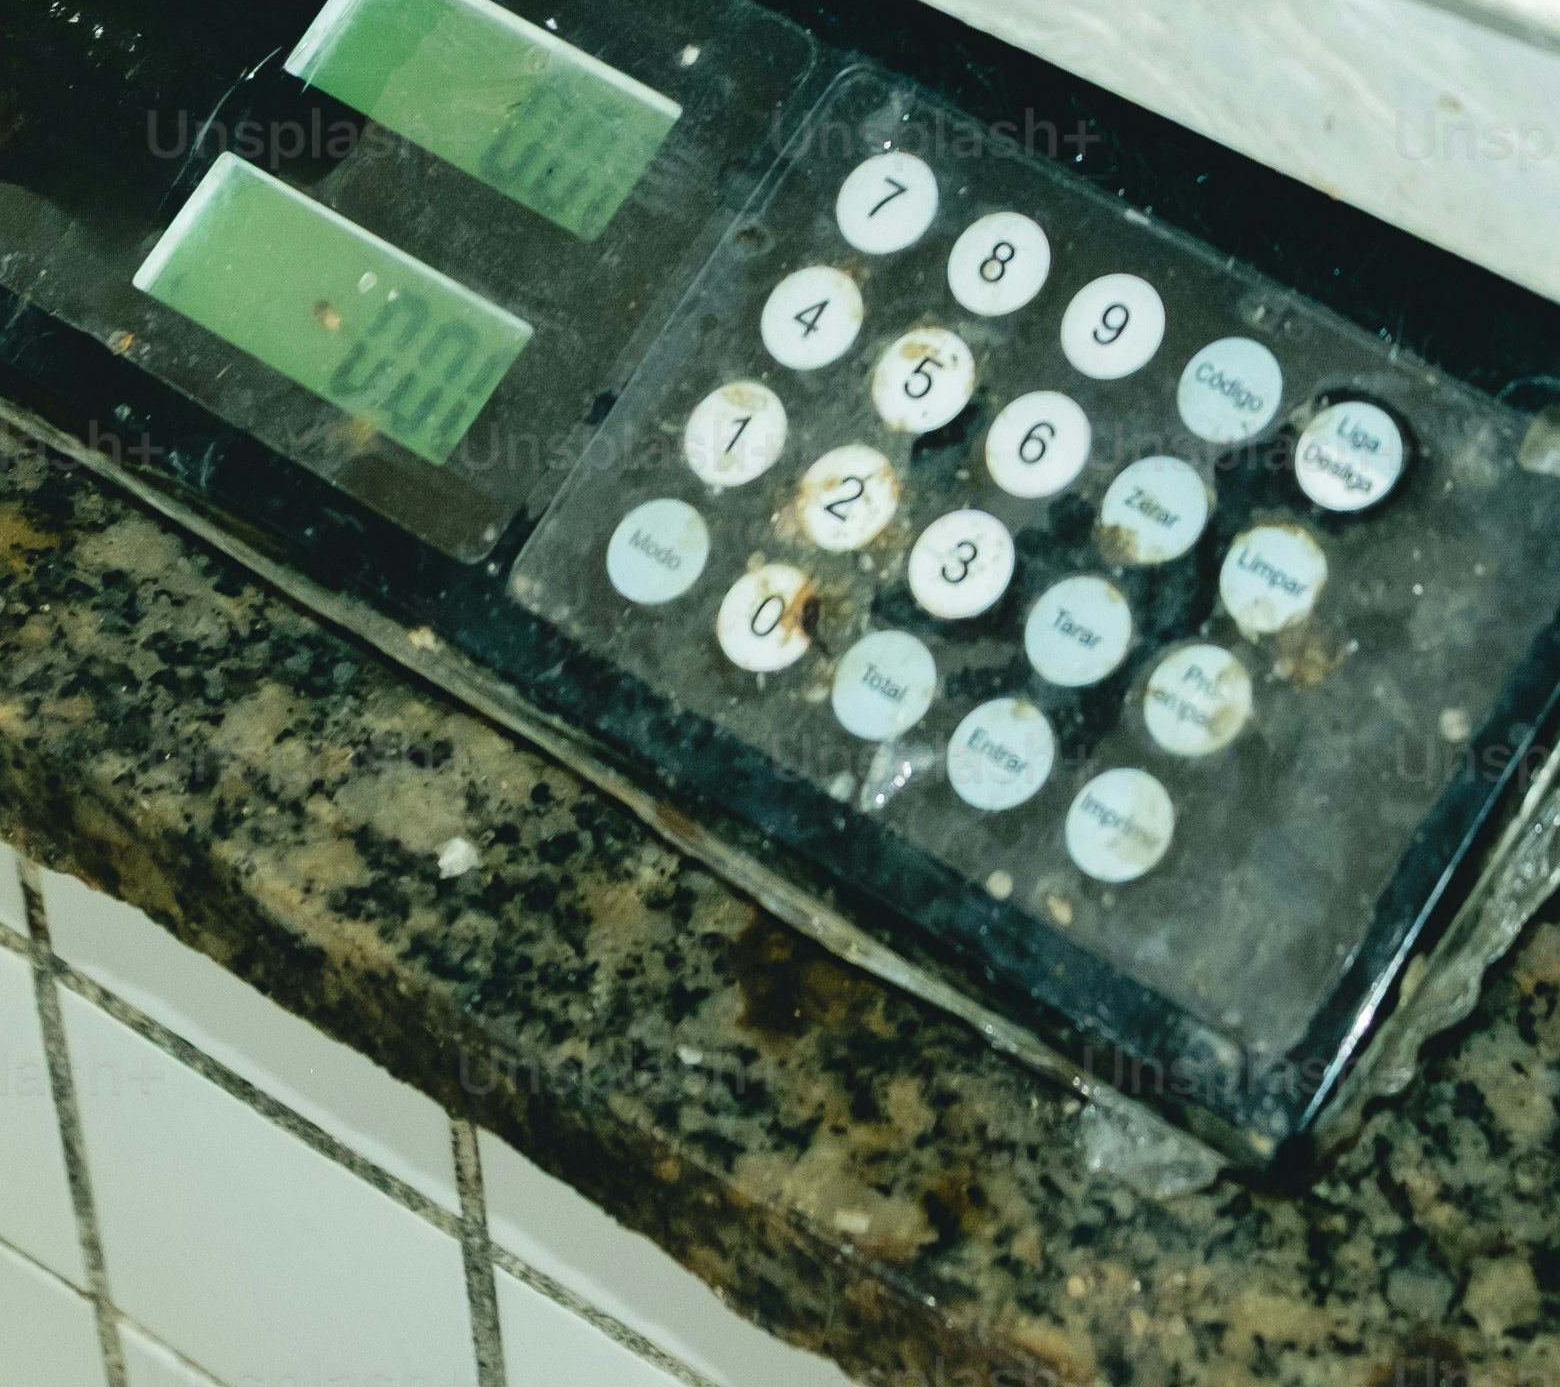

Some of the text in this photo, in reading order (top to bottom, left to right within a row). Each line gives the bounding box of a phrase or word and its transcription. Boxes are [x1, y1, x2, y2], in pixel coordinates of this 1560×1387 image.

[868, 176, 909, 218] 7
[977, 240, 1017, 284] 8
[793, 299, 830, 338] 4
[1092, 303, 1130, 345] 9
[905, 357, 943, 398] 5
[1195, 362, 1264, 413] Código
[725, 415, 752, 455] 1
[1018, 421, 1056, 464] 6
[1336, 415, 1381, 455] Liga
[824, 476, 864, 522] 2
[629, 531, 682, 571] Modo
[942, 541, 978, 583] 3
[1237, 547, 1308, 601] Limpar
[751, 595, 785, 637] 0
[1053, 608, 1101, 650] Tarar
[860, 665, 907, 703] Total
[966, 727, 1029, 775] Entrar
